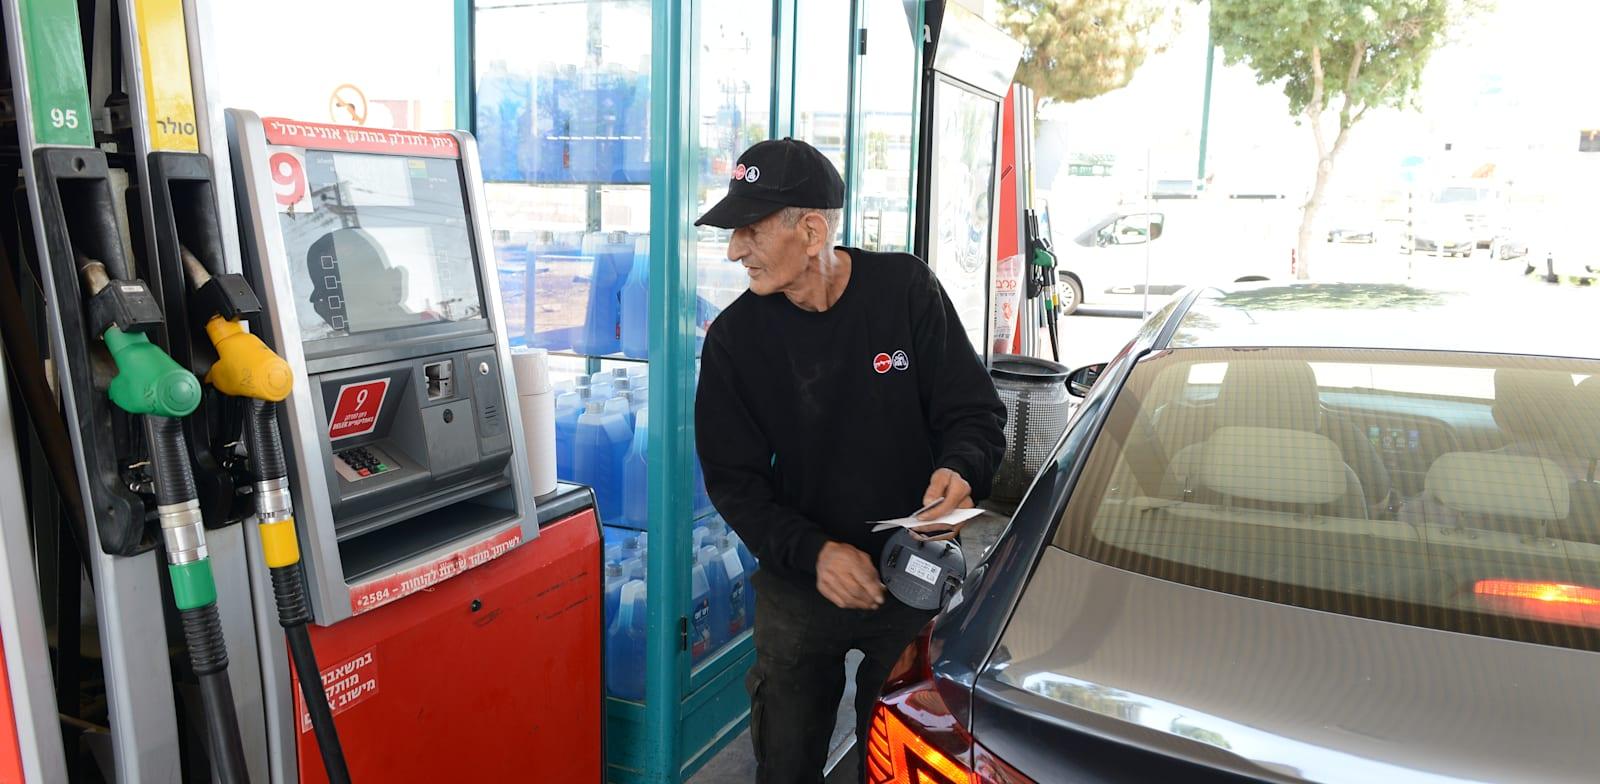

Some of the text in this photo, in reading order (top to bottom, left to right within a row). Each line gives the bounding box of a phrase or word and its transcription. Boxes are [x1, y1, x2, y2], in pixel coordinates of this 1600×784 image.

[50, 108, 79, 129] 95
[156, 116, 195, 135] סולר
[270, 121, 454, 149] ניתן לתדלק בהתקן אוניברסלי
[269, 152, 306, 206] 9
[354, 389, 369, 412] 9
[338, 679, 376, 706] מישוב
